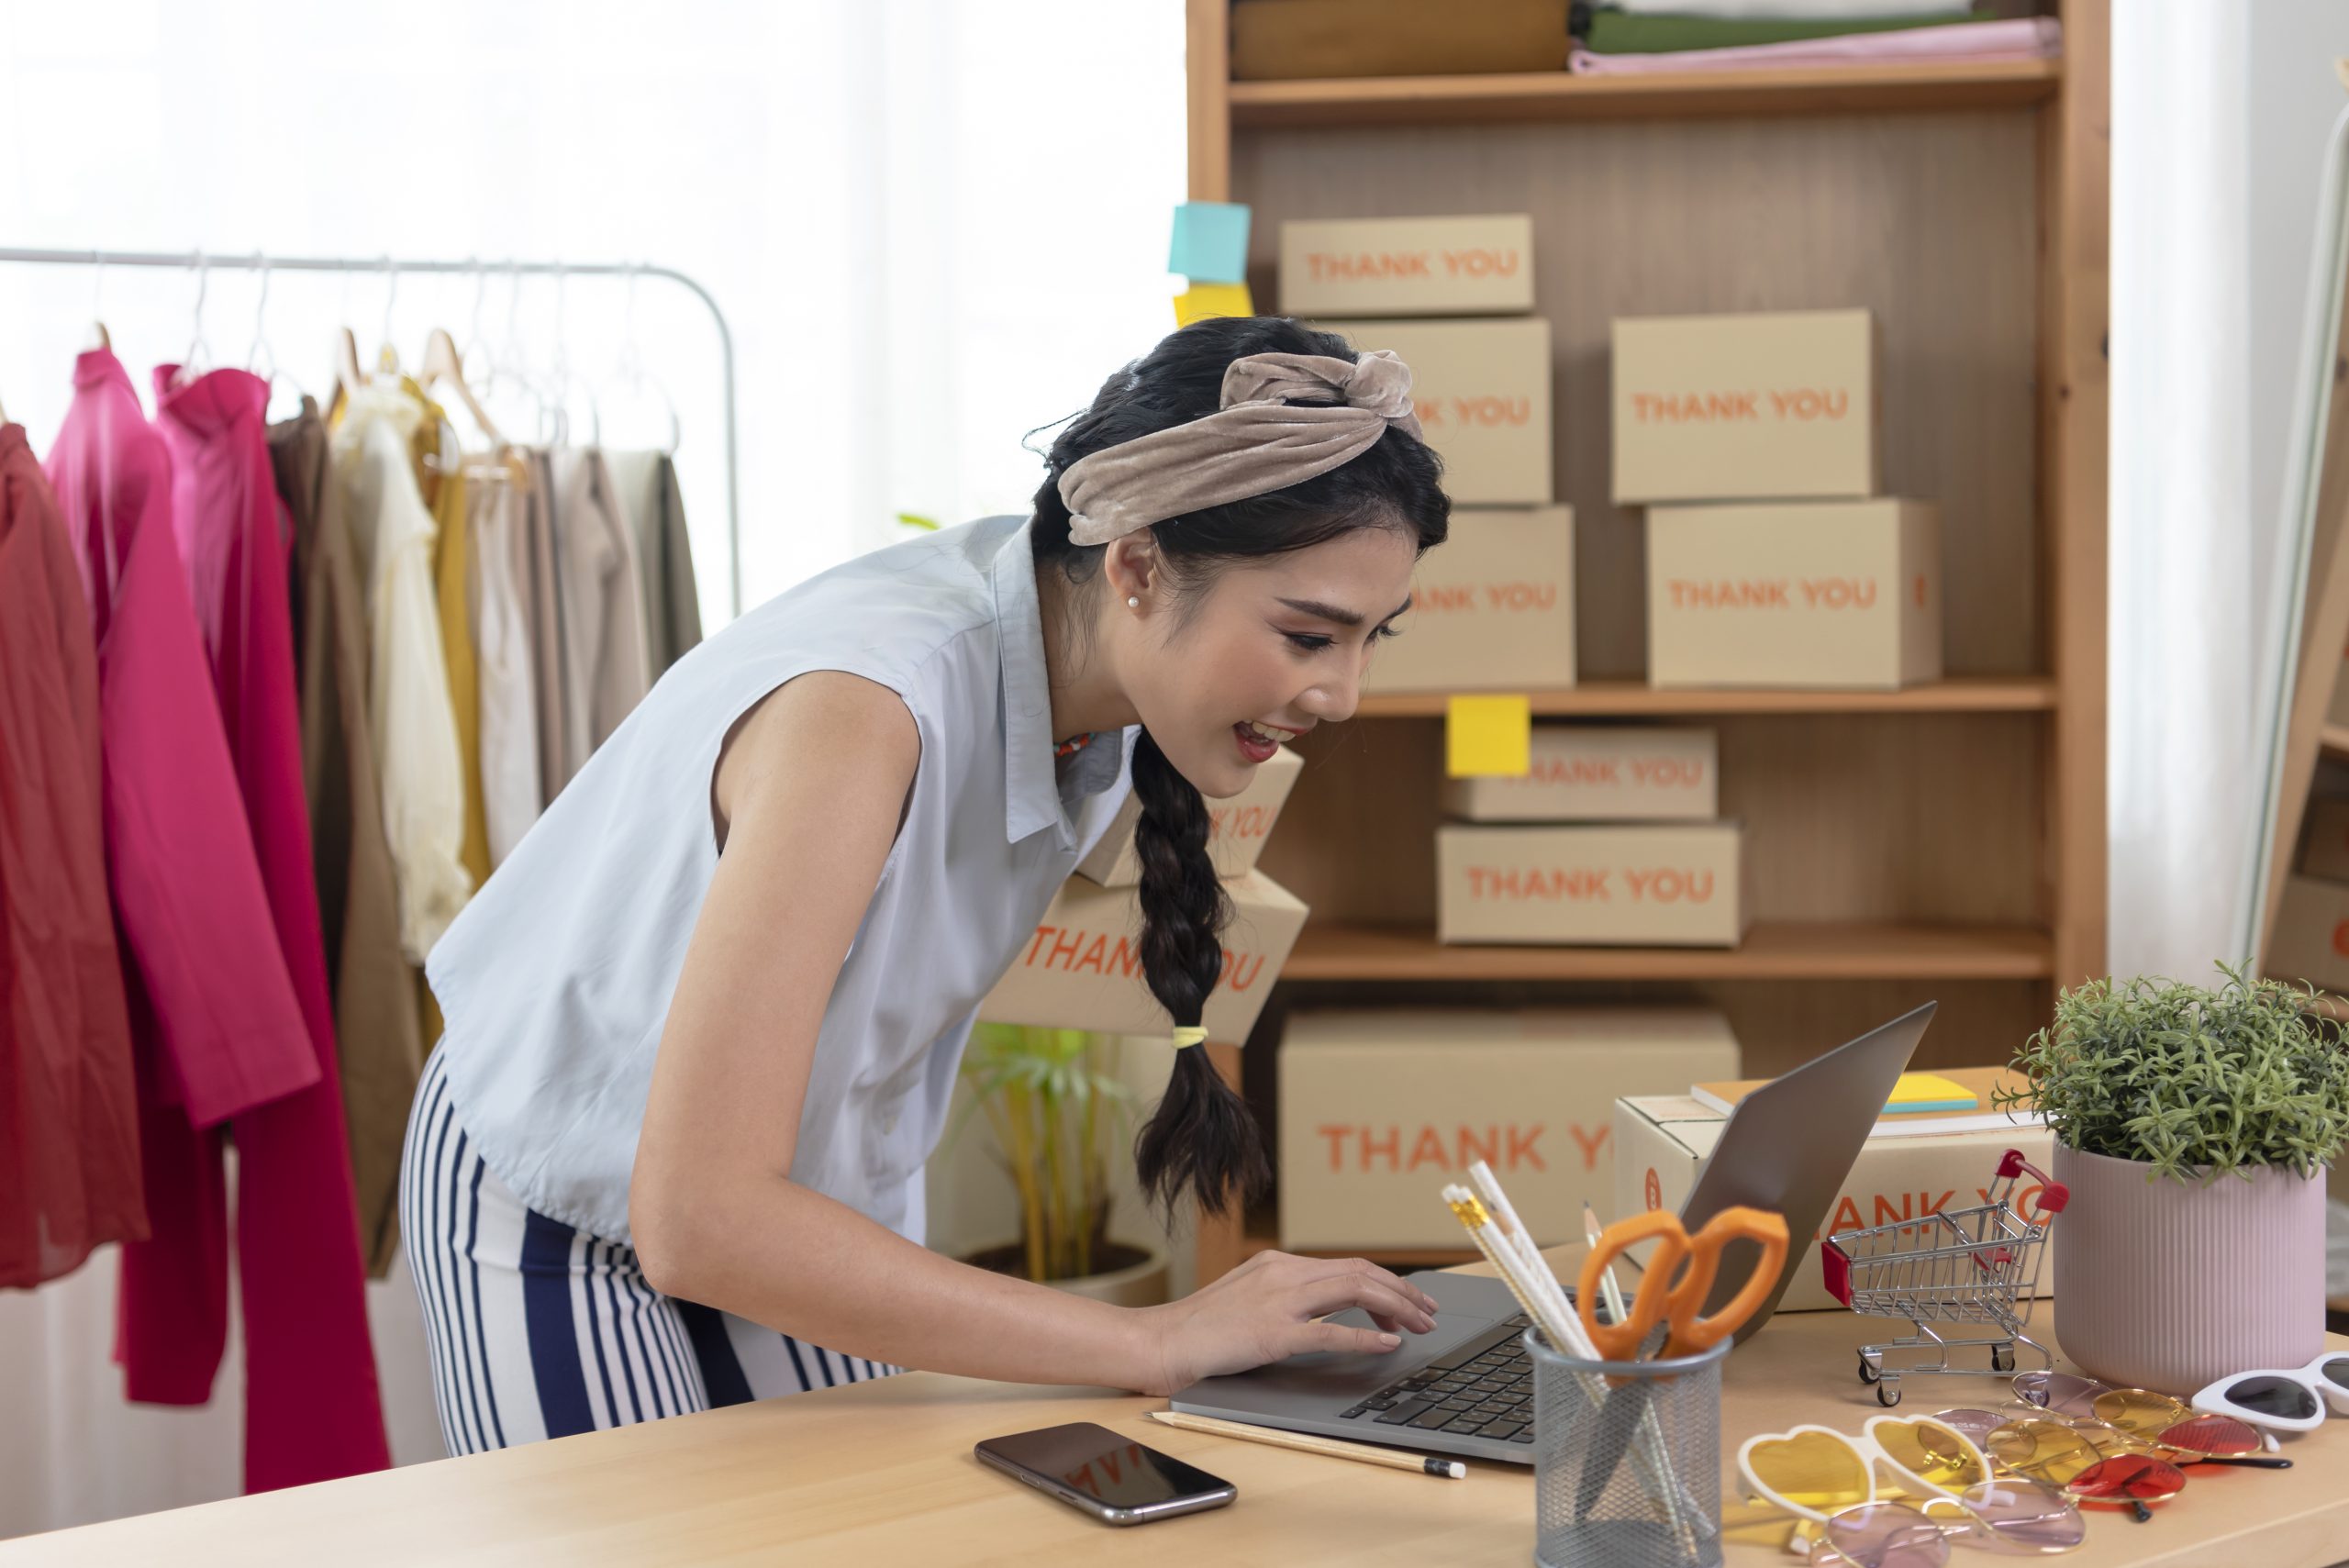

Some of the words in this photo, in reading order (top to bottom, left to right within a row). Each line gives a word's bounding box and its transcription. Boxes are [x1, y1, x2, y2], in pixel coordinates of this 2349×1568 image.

[1307, 251, 1431, 281] THANK
[1442, 249, 1519, 278] YOU
[1453, 395, 1530, 428] YOU
[1631, 392, 1758, 422] THANK
[1767, 388, 1848, 420] YOU
[1409, 584, 1475, 615] ANK
[1483, 581, 1557, 612] YOU
[1667, 578, 1789, 609] THANK
[1798, 577, 1876, 610] YOU
[1505, 754, 1619, 787] HANK
[1630, 756, 1704, 789] YOU
[1464, 866, 1612, 902] THANK
[1622, 866, 1714, 905] YOU
[1026, 926, 1144, 978] THAN
[1317, 1124, 1547, 1173] THANK
[1812, 1190, 1956, 1241] ANK
